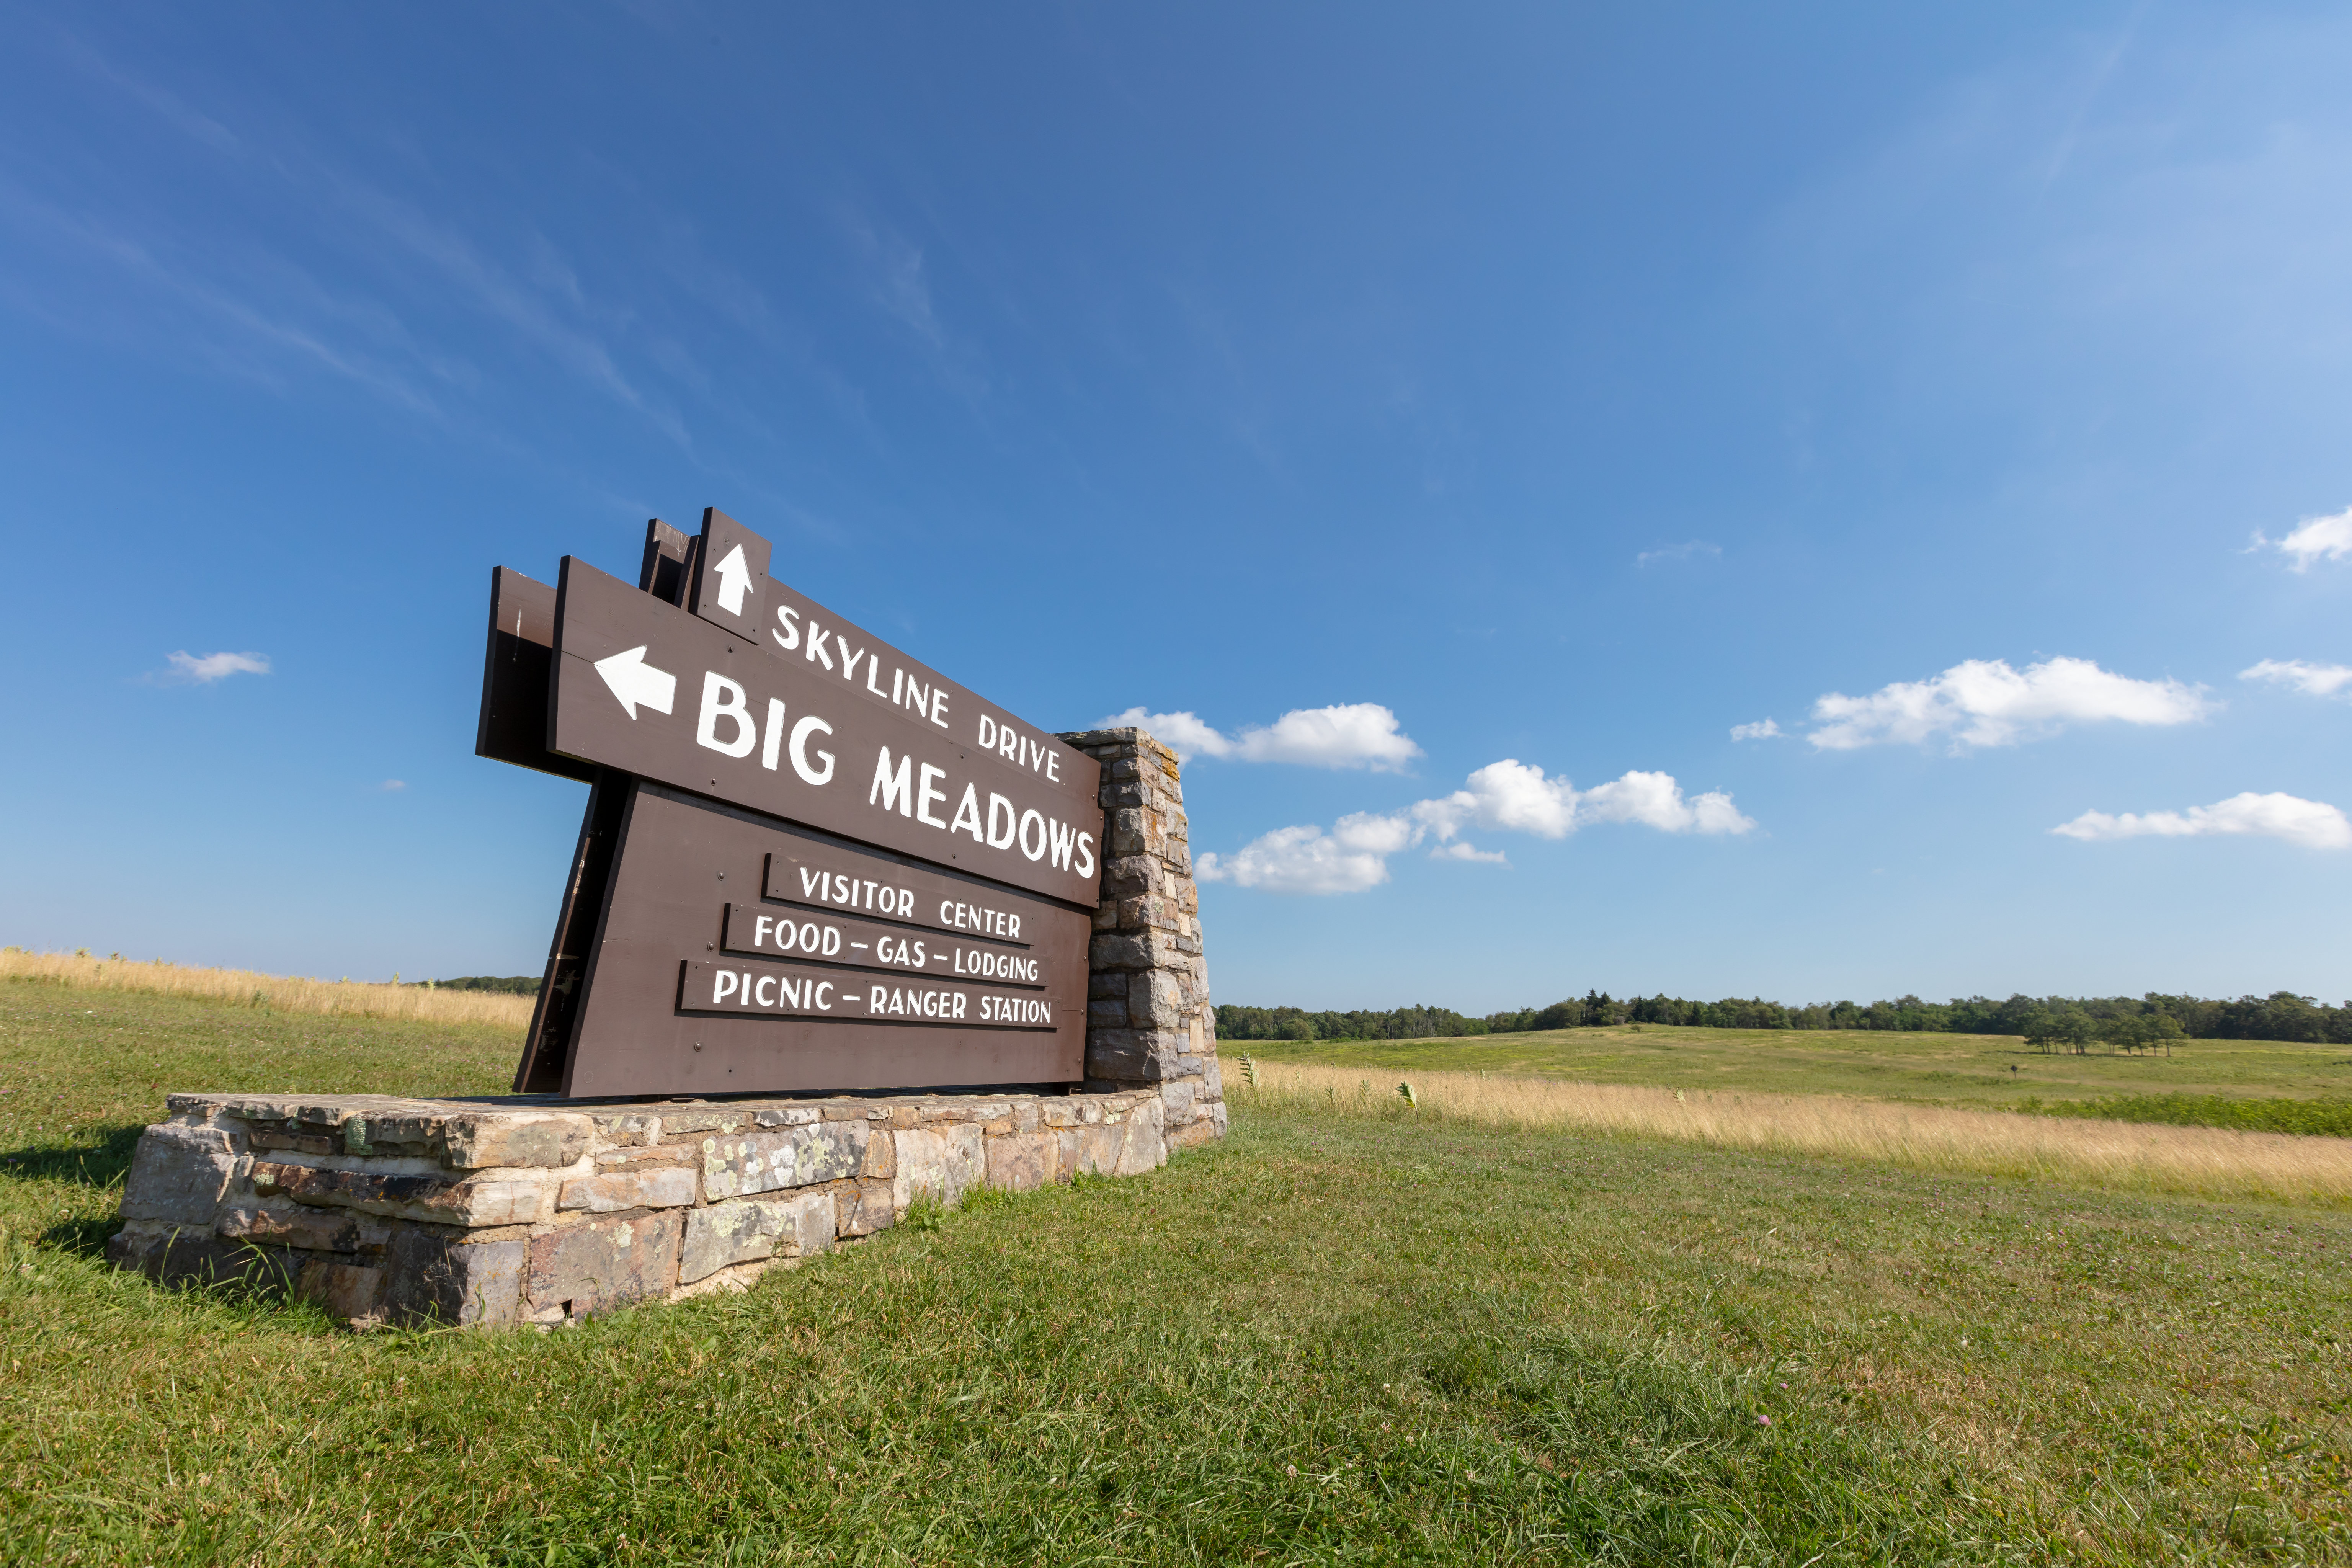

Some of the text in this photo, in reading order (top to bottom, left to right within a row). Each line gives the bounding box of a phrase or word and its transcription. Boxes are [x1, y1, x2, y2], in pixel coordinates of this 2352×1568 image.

[772, 605, 1060, 783] SKYLINE DRIVE
[696, 670, 1094, 879] BIG MEADOWS
[800, 867, 1021, 938] VISITOR CENTER
[755, 915, 841, 956] FOOD
[877, 936, 926, 967] GAS
[955, 947, 1038, 982] LODGING
[713, 970, 834, 1010] PICNIC
[870, 985, 967, 1018] RANGER
[979, 995, 1051, 1024] STATION
